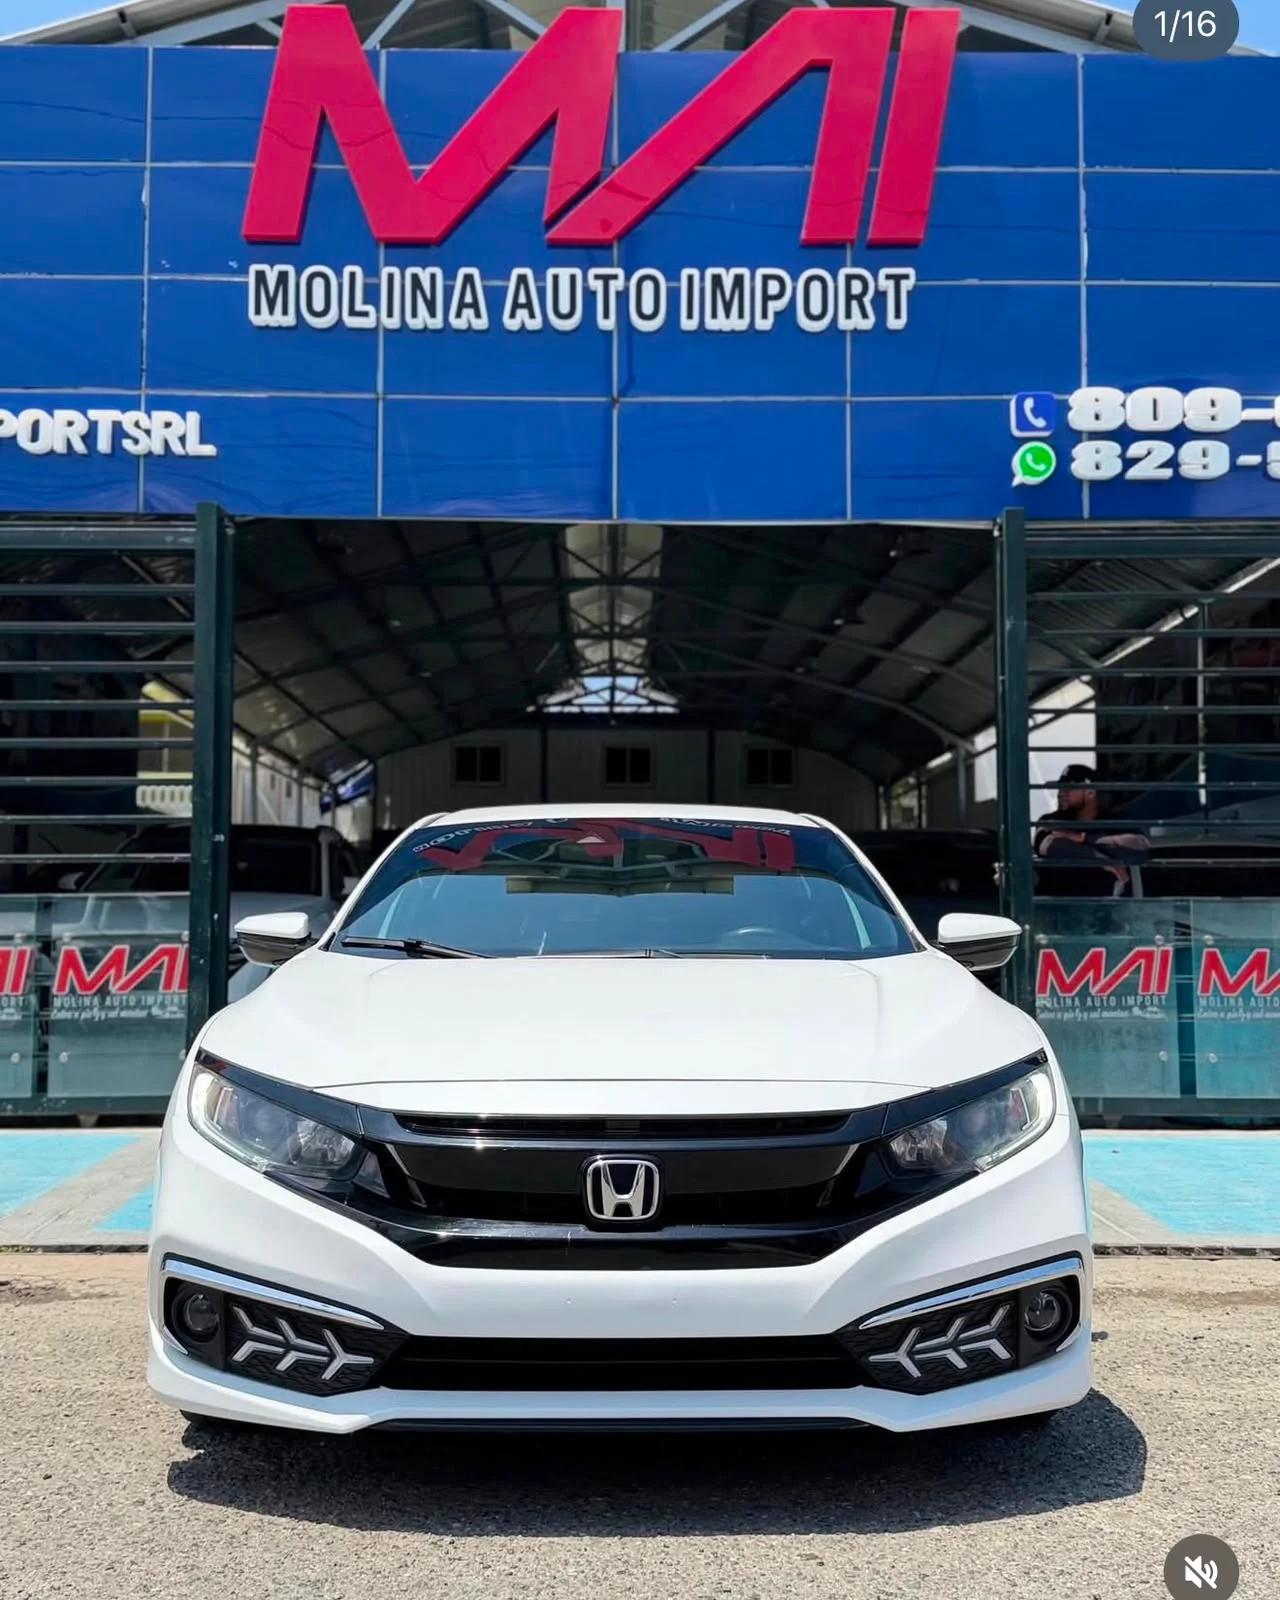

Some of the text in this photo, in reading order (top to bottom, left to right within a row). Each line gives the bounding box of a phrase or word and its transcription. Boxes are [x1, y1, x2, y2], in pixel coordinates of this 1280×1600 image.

[242, 4, 961, 245] MAI
[248, 263, 917, 333] MOLINA AUTO IMPORT
[1067, 386, 1280, 433] 809-
[1070, 439, 1280, 481] 829-
[52, 943, 190, 996] MAI
[1035, 945, 1174, 997] MAI
[53, 994, 188, 1008] MOLINA AUTO IMPORT
[1086, 995, 1117, 1008] AUTO
[1121, 994, 1167, 1007] IMPORT
[1199, 996, 1280, 1008] MOLINA AUTO
